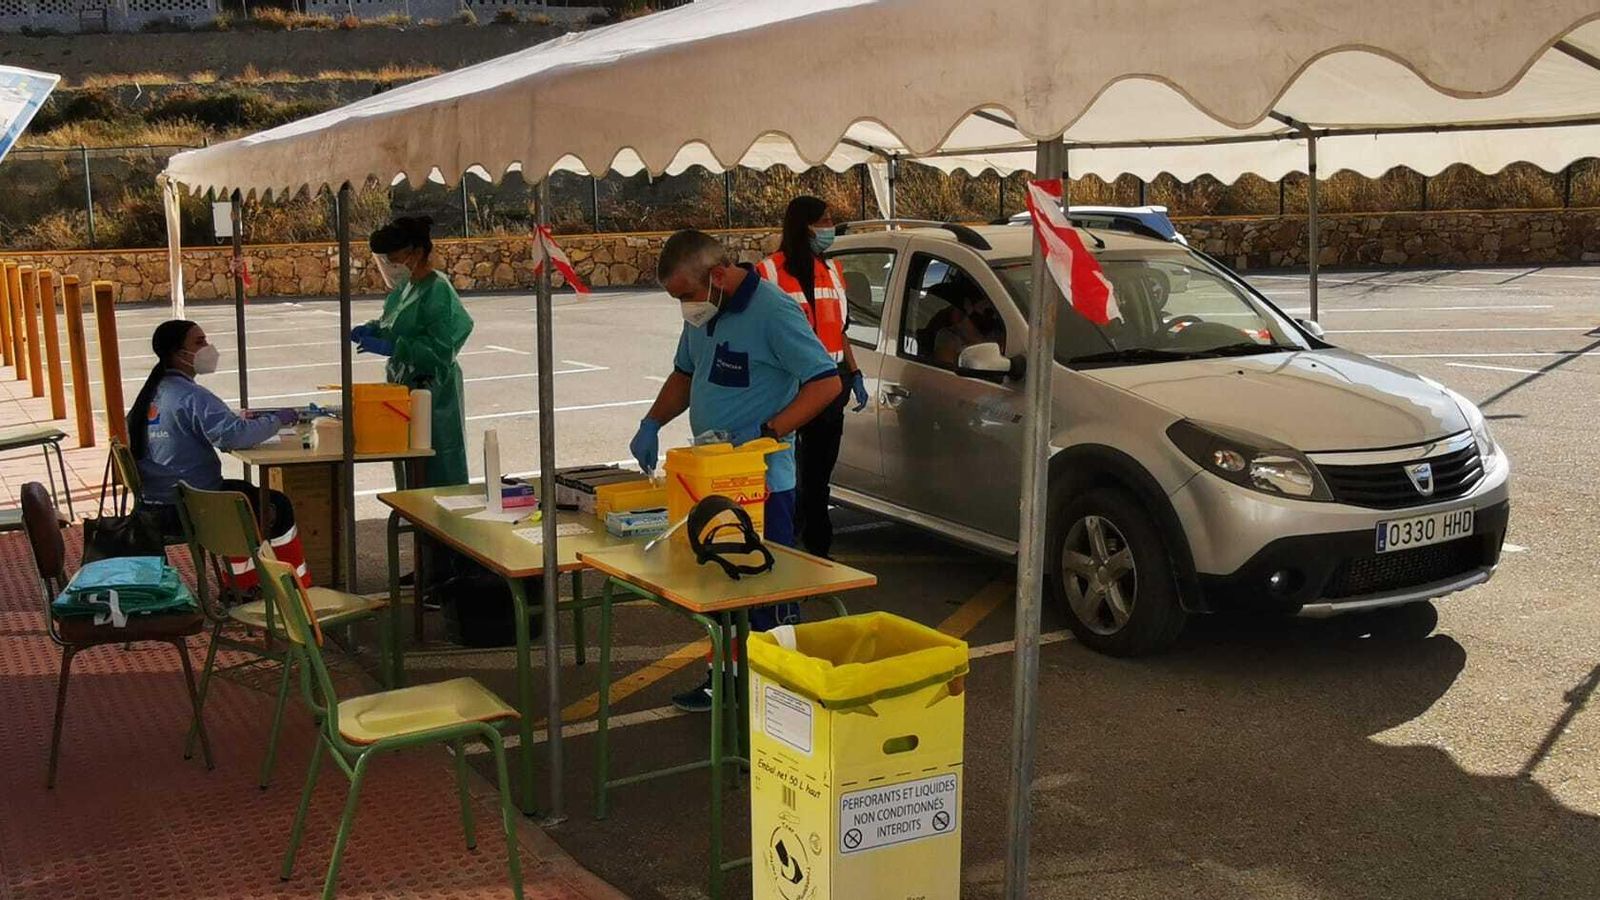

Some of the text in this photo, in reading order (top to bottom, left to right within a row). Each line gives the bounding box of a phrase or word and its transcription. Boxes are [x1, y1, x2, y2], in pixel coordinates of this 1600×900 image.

[1389, 511, 1472, 546] 0330 HHD
[842, 779, 955, 811] PERFORANTS ET LIQUIDES
[854, 798, 944, 827] NON CONDITIONNÉS
[877, 819, 921, 838] INTERDITS
